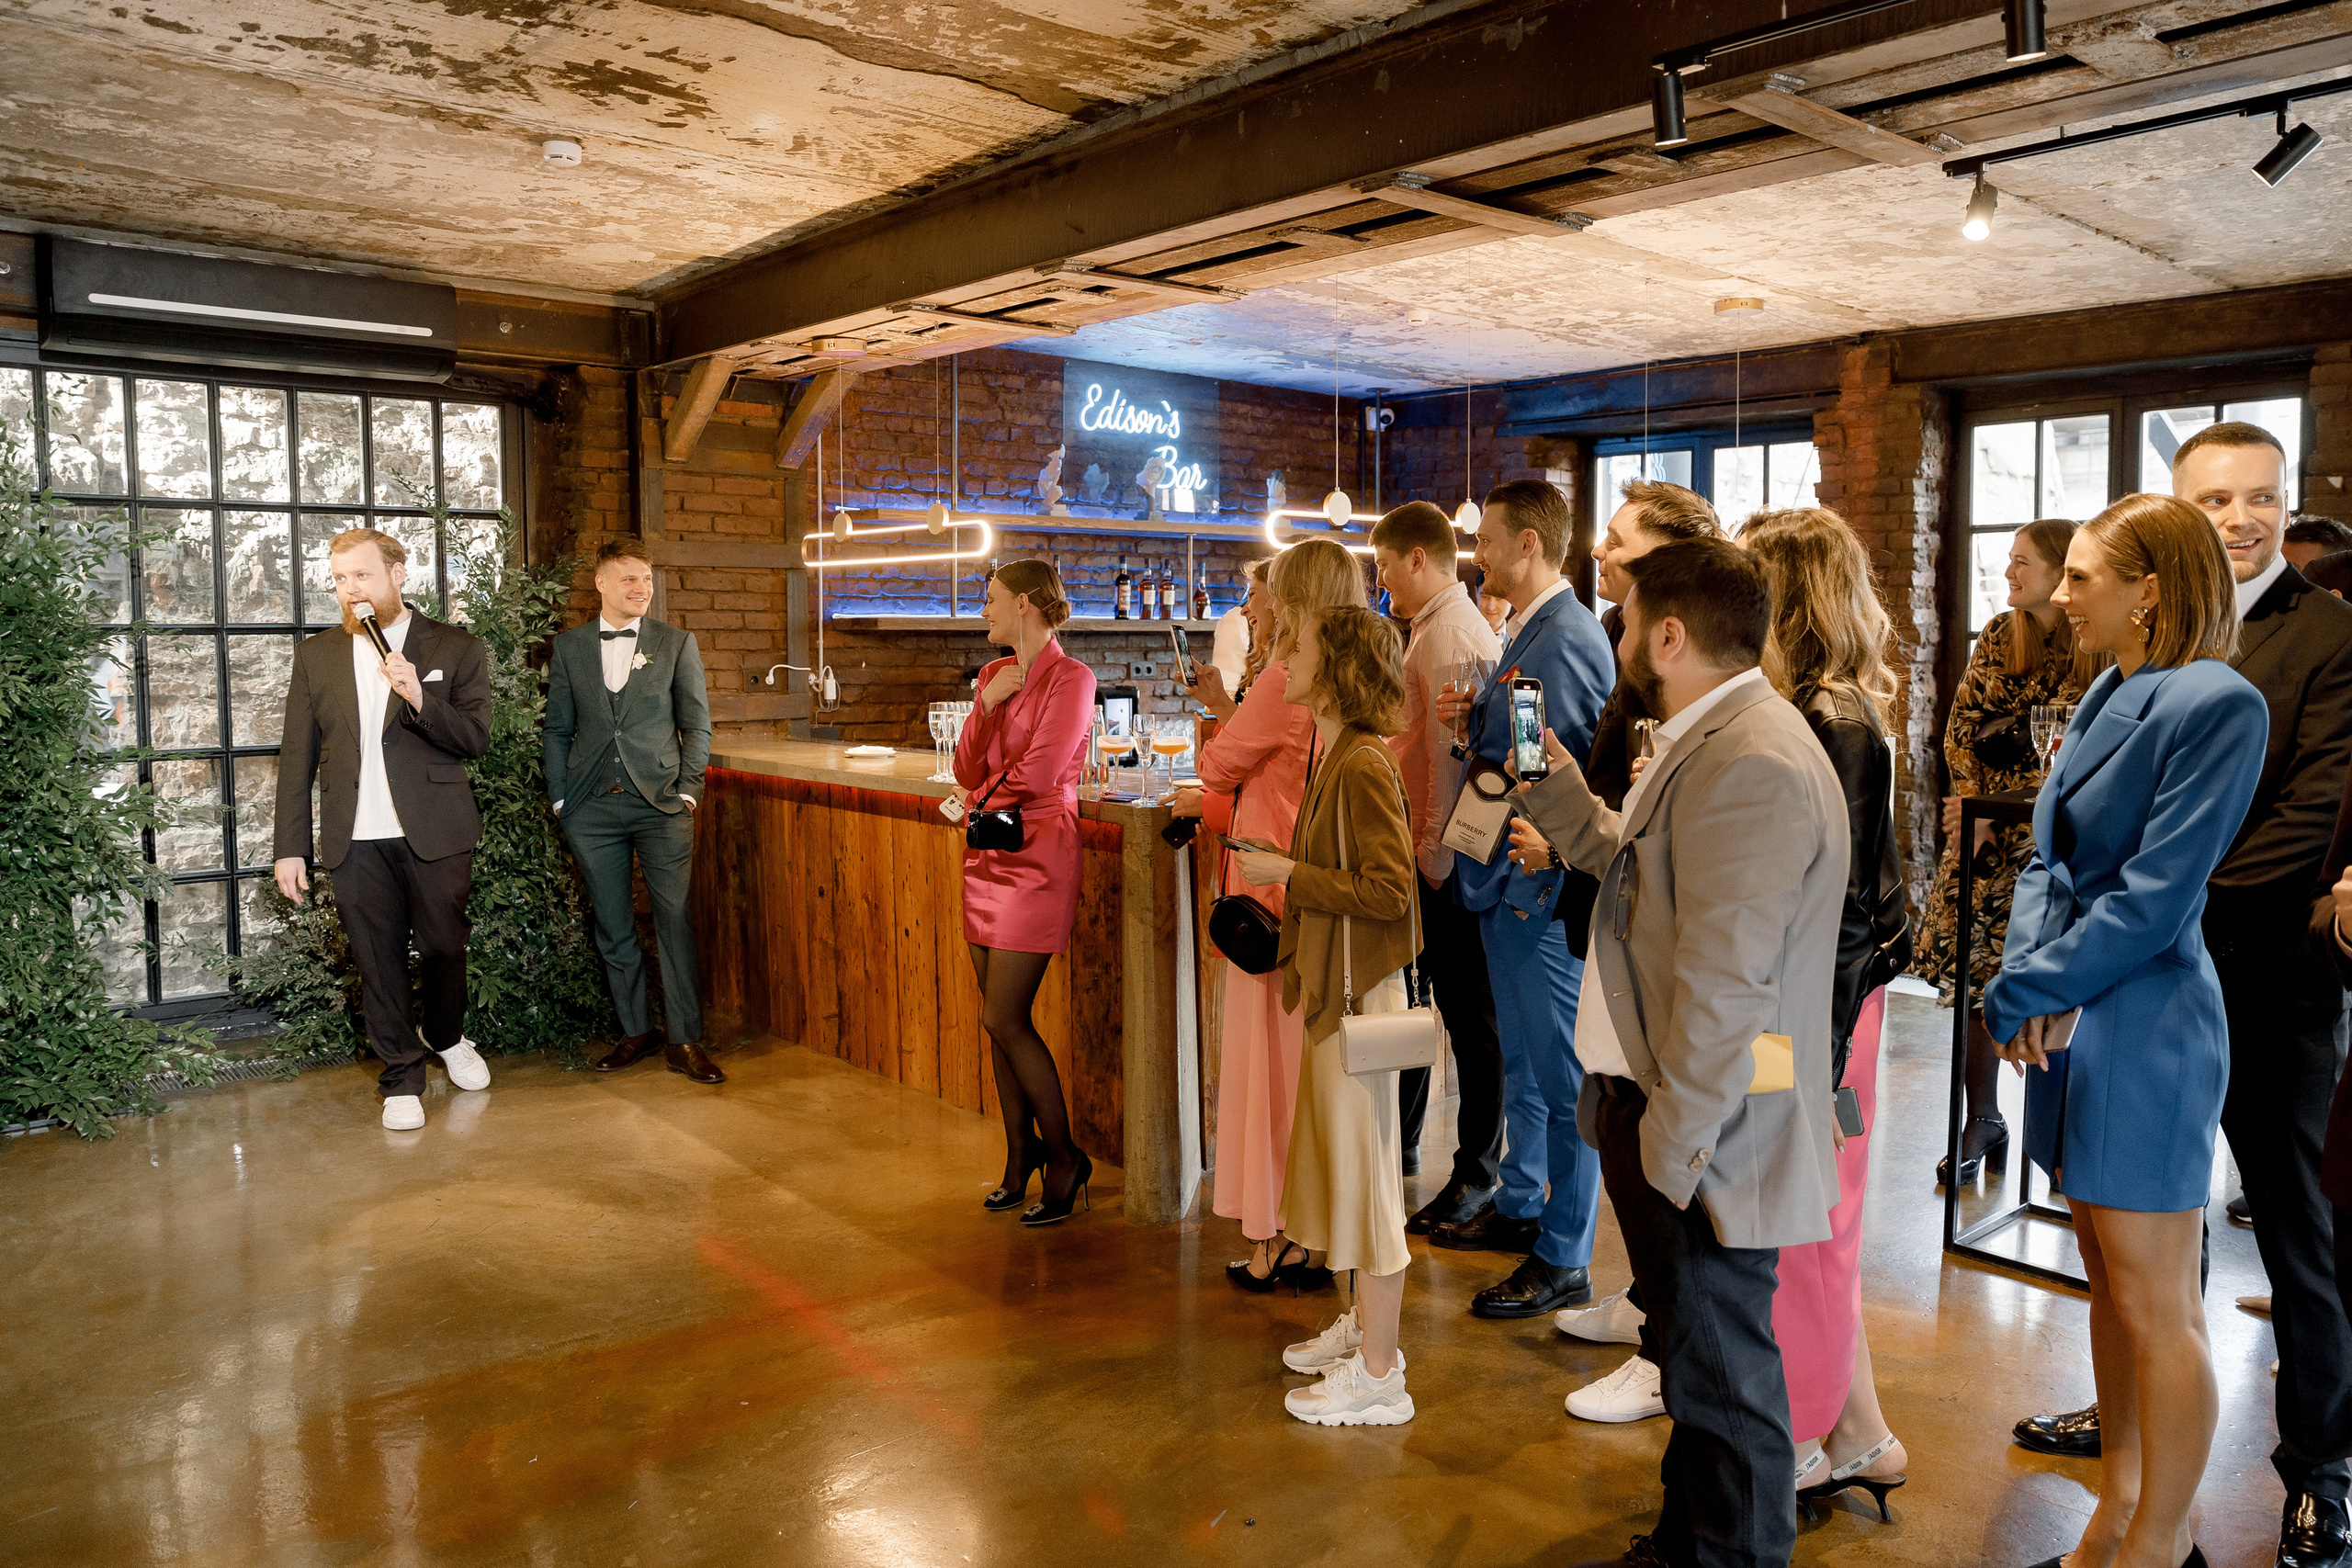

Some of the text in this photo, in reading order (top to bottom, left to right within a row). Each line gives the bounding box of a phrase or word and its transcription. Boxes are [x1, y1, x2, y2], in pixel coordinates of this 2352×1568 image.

[1080, 383, 1181, 439] Edison's
[1155, 446, 1208, 490] Bar
[1456, 818, 1487, 838] BURBERRY
